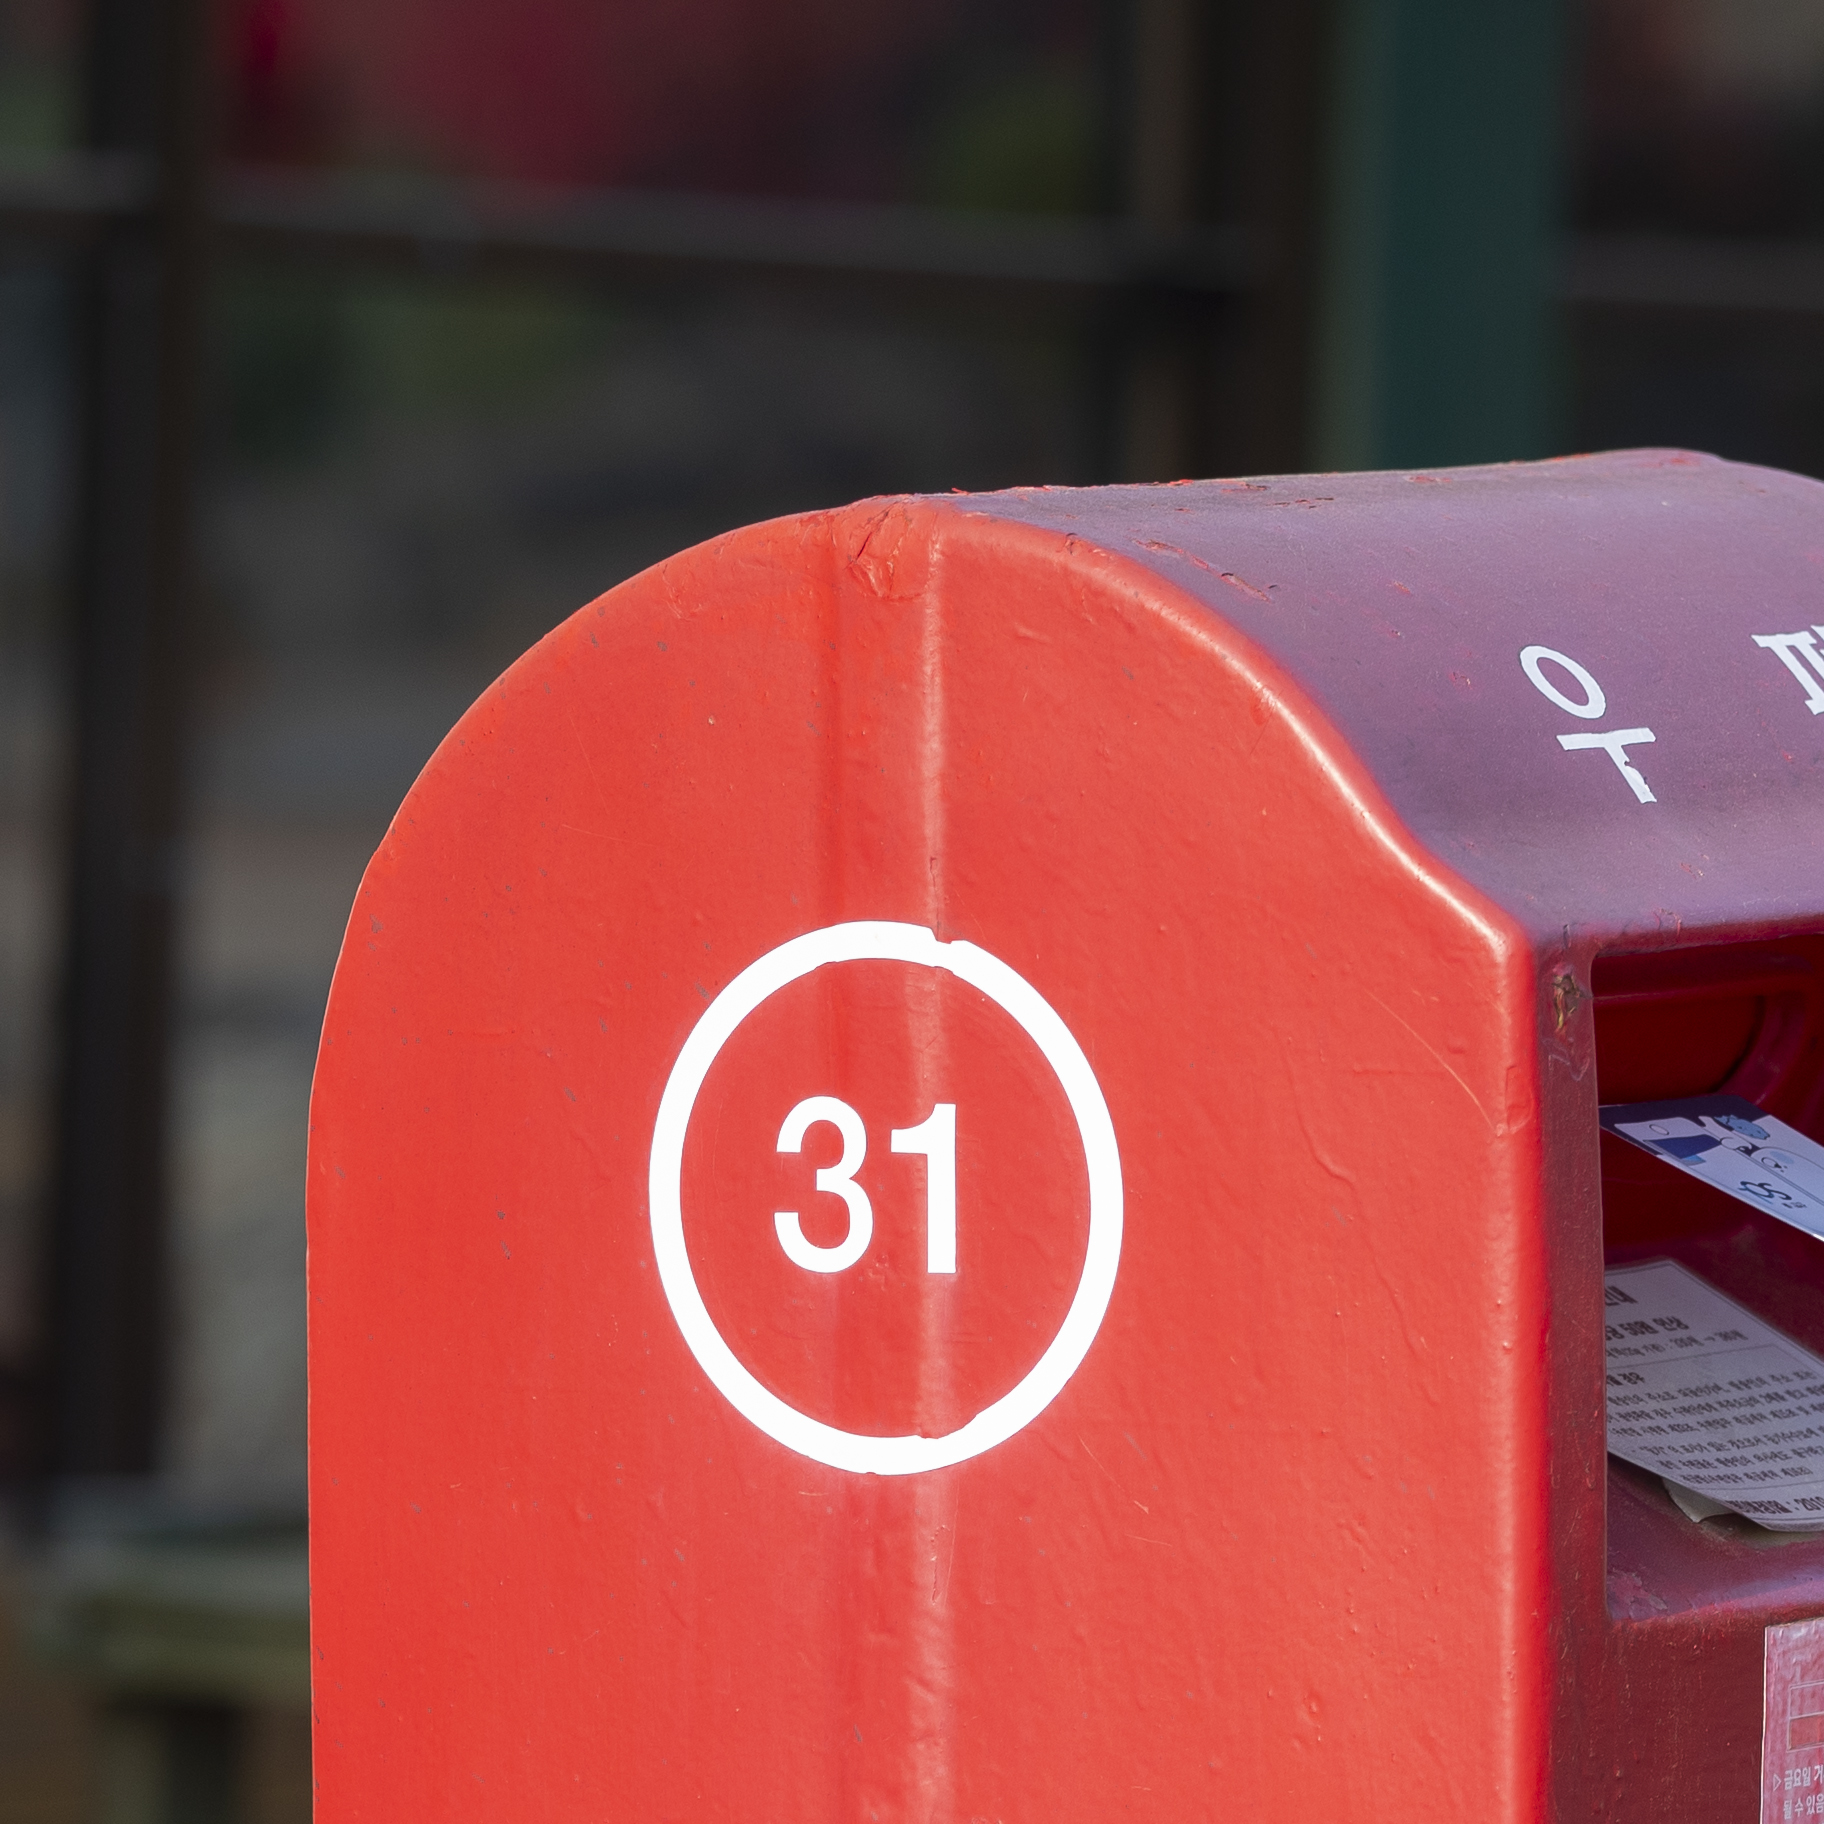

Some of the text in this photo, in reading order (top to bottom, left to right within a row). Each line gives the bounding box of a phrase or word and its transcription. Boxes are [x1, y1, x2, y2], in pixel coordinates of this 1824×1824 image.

[774, 1096, 958, 1274] 31
[1784, 1766, 1810, 1790] 금요일
[1782, 1797, 1792, 1820] 될
[1794, 1797, 1803, 1817] 수
